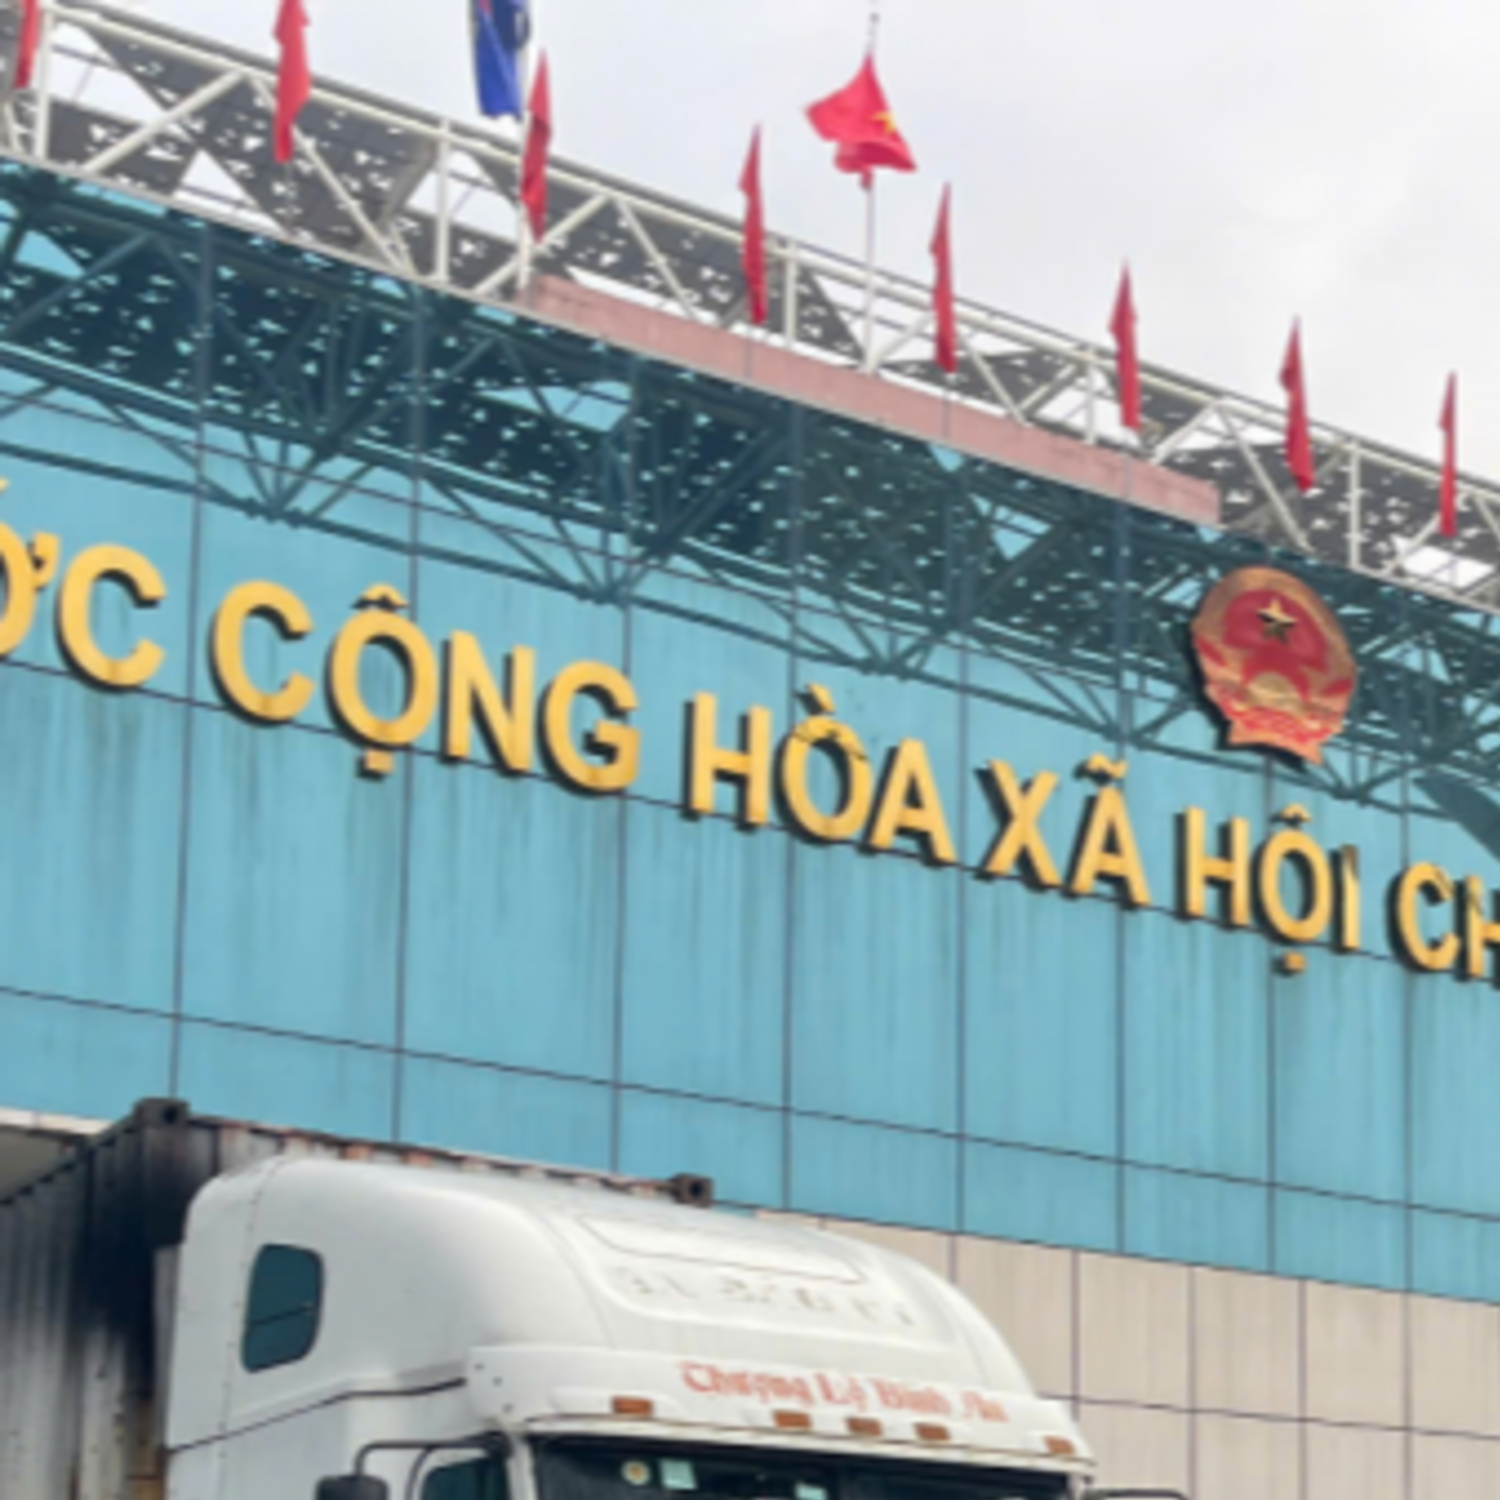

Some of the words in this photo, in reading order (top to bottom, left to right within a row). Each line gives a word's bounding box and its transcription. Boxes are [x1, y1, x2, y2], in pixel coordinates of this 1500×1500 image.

[212, 584, 641, 793] CỘNG
[688, 683, 955, 865] HÒA
[987, 754, 1151, 906] XÃ
[1185, 804, 1360, 972] HỘI
